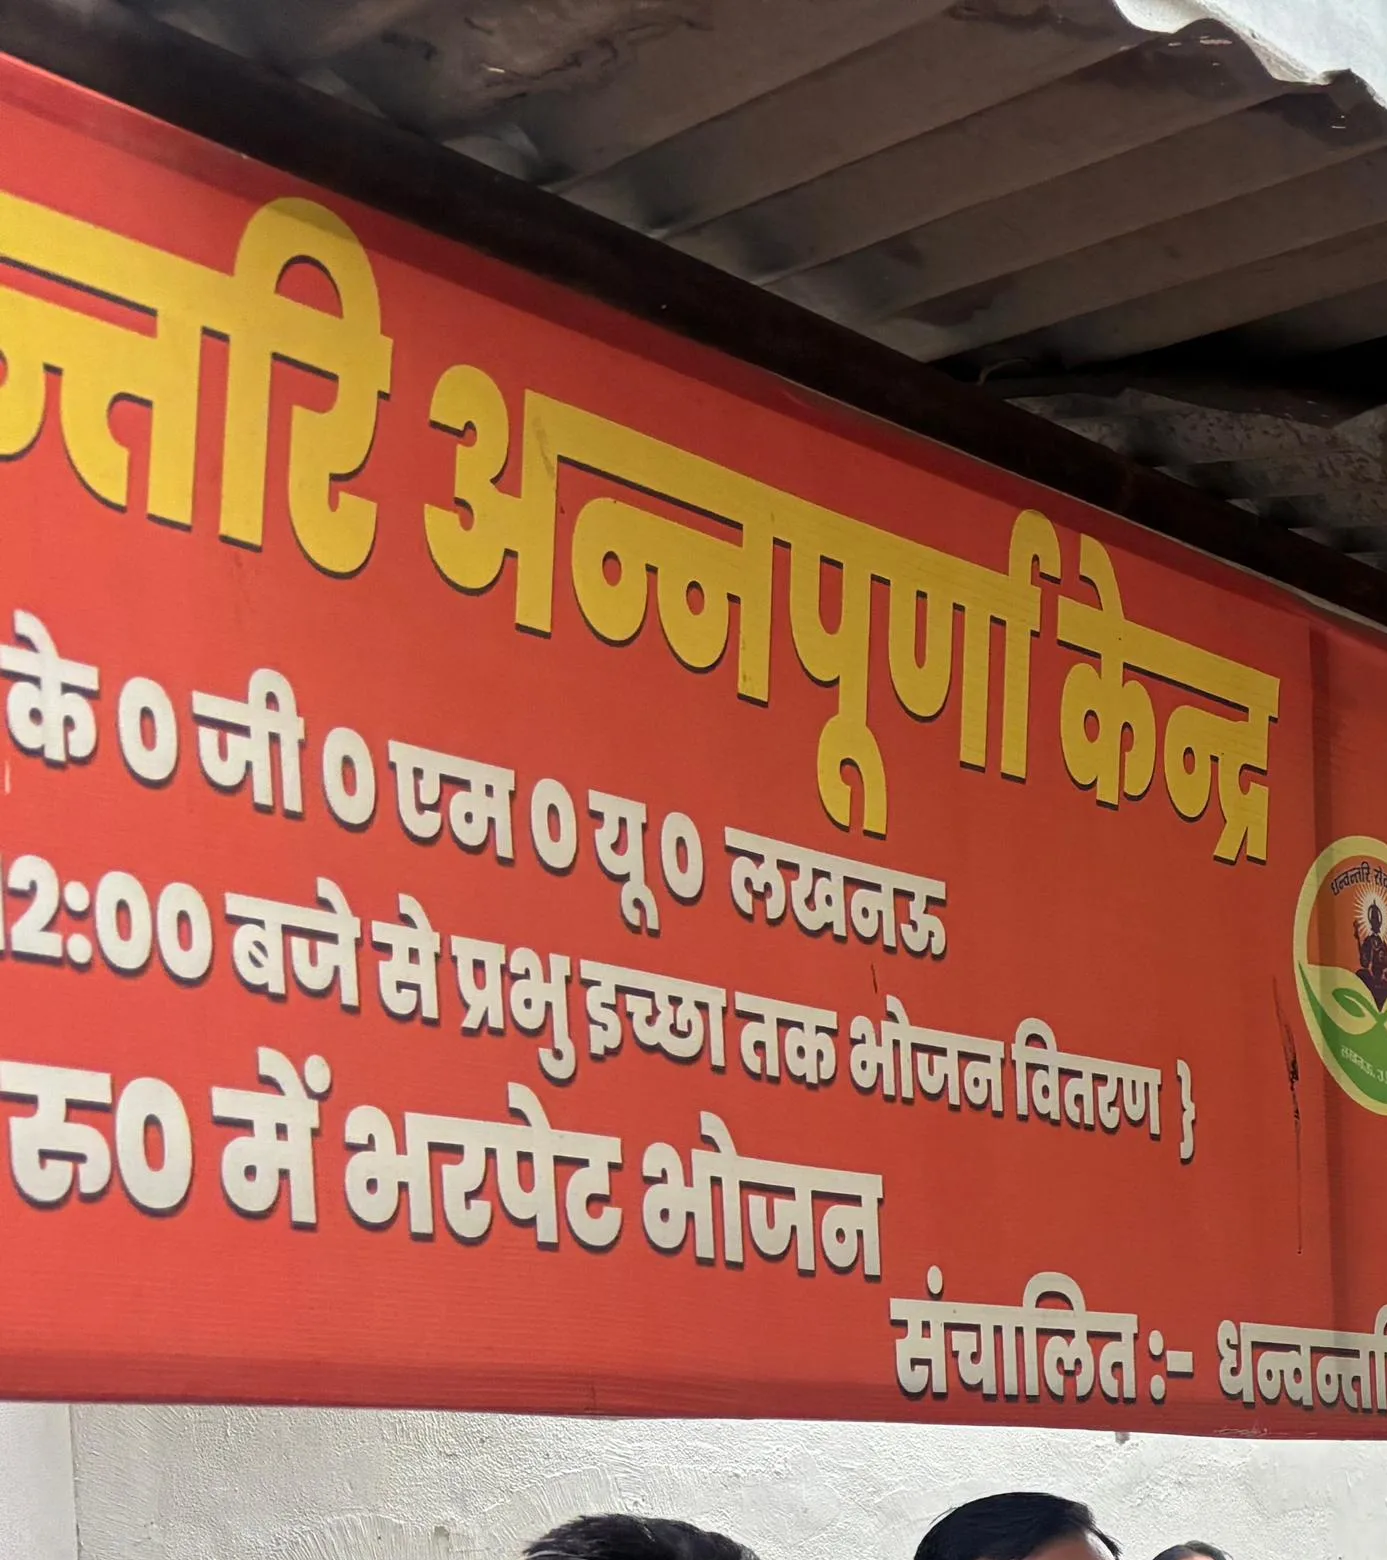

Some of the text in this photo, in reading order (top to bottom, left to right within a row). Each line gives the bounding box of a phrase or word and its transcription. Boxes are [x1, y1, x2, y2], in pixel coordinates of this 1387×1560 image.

[425, 365, 1060, 836] अन्नपूर्णा
[1058, 533, 1280, 862] केन्द्र
[224, 877, 362, 1008] बजे
[371, 893, 441, 1020] से
[450, 935, 577, 1080] प्रभु
[579, 959, 727, 1067] इच्छा
[735, 991, 838, 1084] तक
[849, 994, 1005, 1112] भोजन
[1012, 1017, 1162, 1135] वितरण
[725, 827, 946, 955] लखनऊ
[210, 1046, 332, 1225] में
[344, 1082, 623, 1247] भरपेट
[642, 1111, 884, 1276] भोजन
